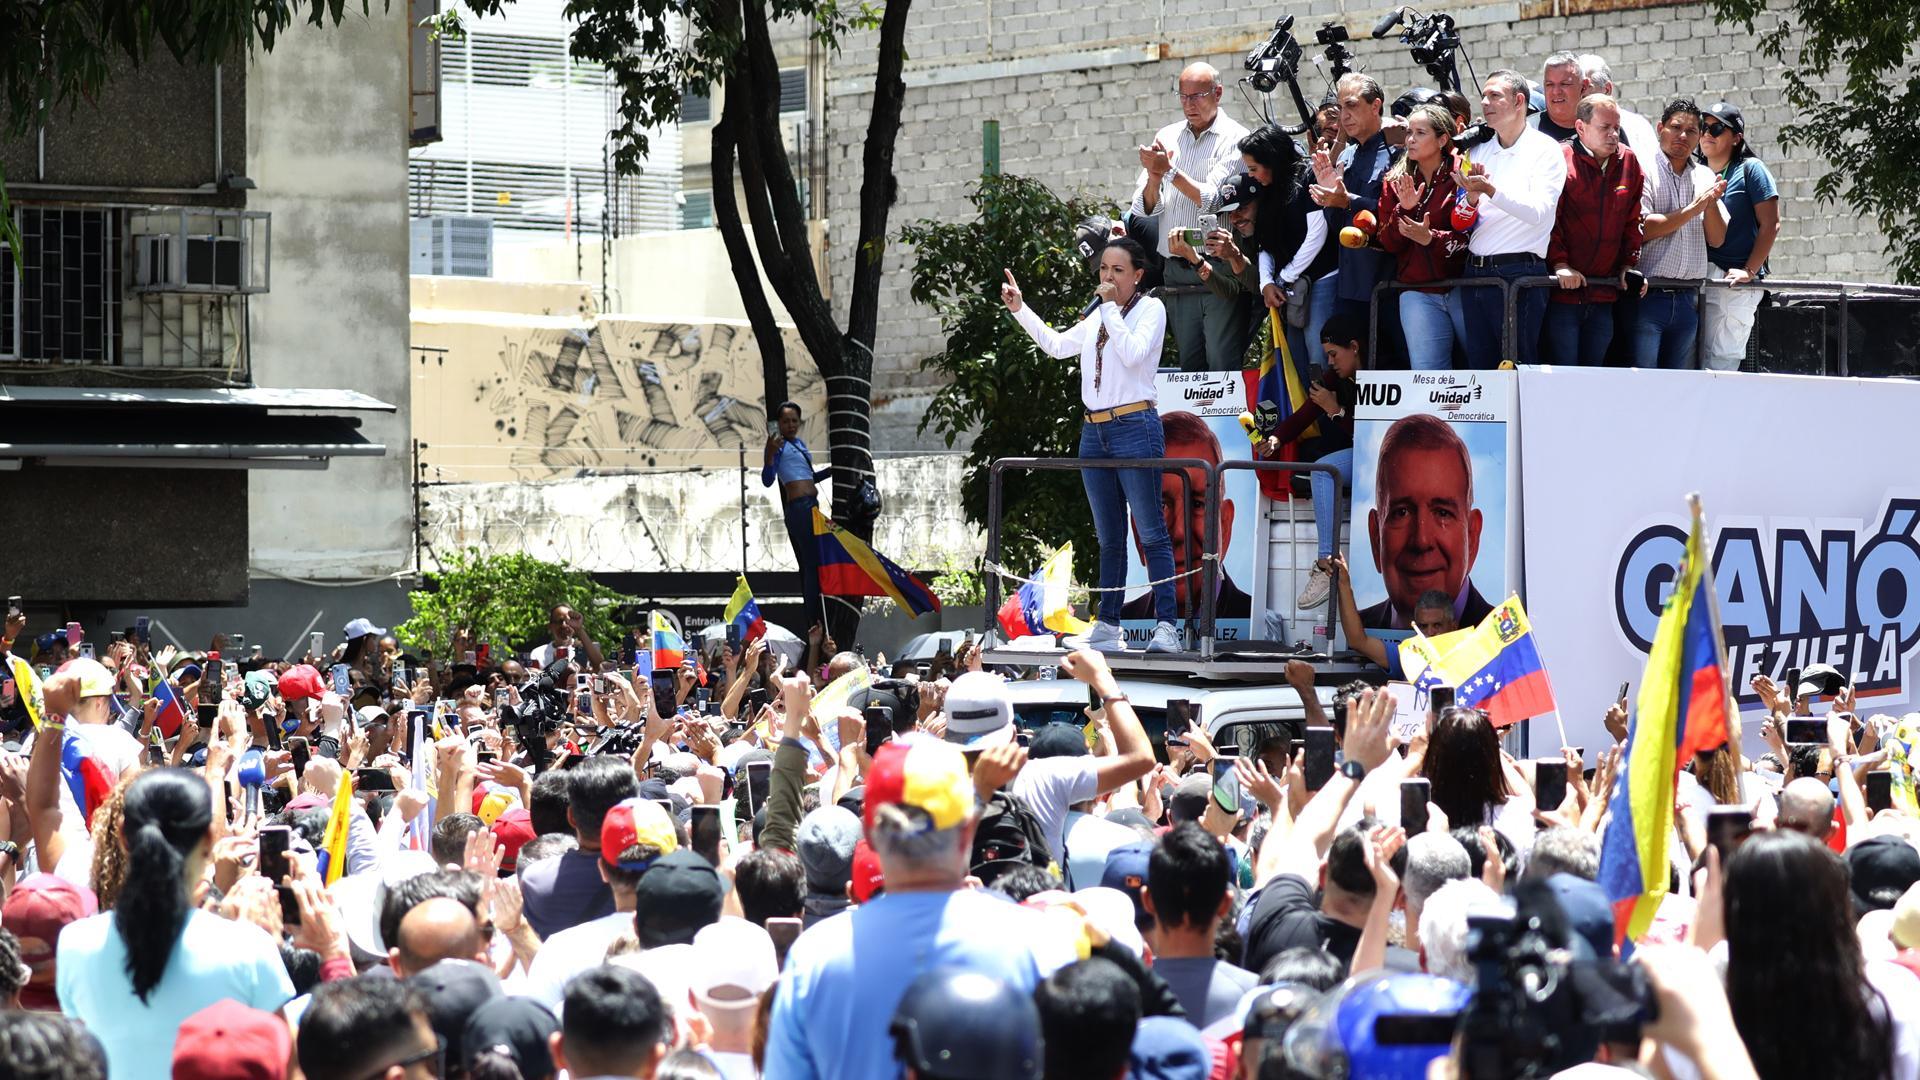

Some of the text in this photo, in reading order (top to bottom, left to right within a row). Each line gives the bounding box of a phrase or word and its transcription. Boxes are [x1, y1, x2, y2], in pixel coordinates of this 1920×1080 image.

[1167, 373, 1189, 383] Mesa
[1412, 374, 1436, 385] Mesa
[1184, 386, 1225, 400] Unidad
[1353, 383, 1402, 406] MUD
[1429, 390, 1472, 404] Unidad
[1201, 406, 1247, 415] Democrática
[1448, 411, 1496, 421] Democrática
[1615, 498, 1920, 655] GANÓ
[685, 616, 720, 626] Entrada
[1175, 628, 1238, 642] GNLEZ
